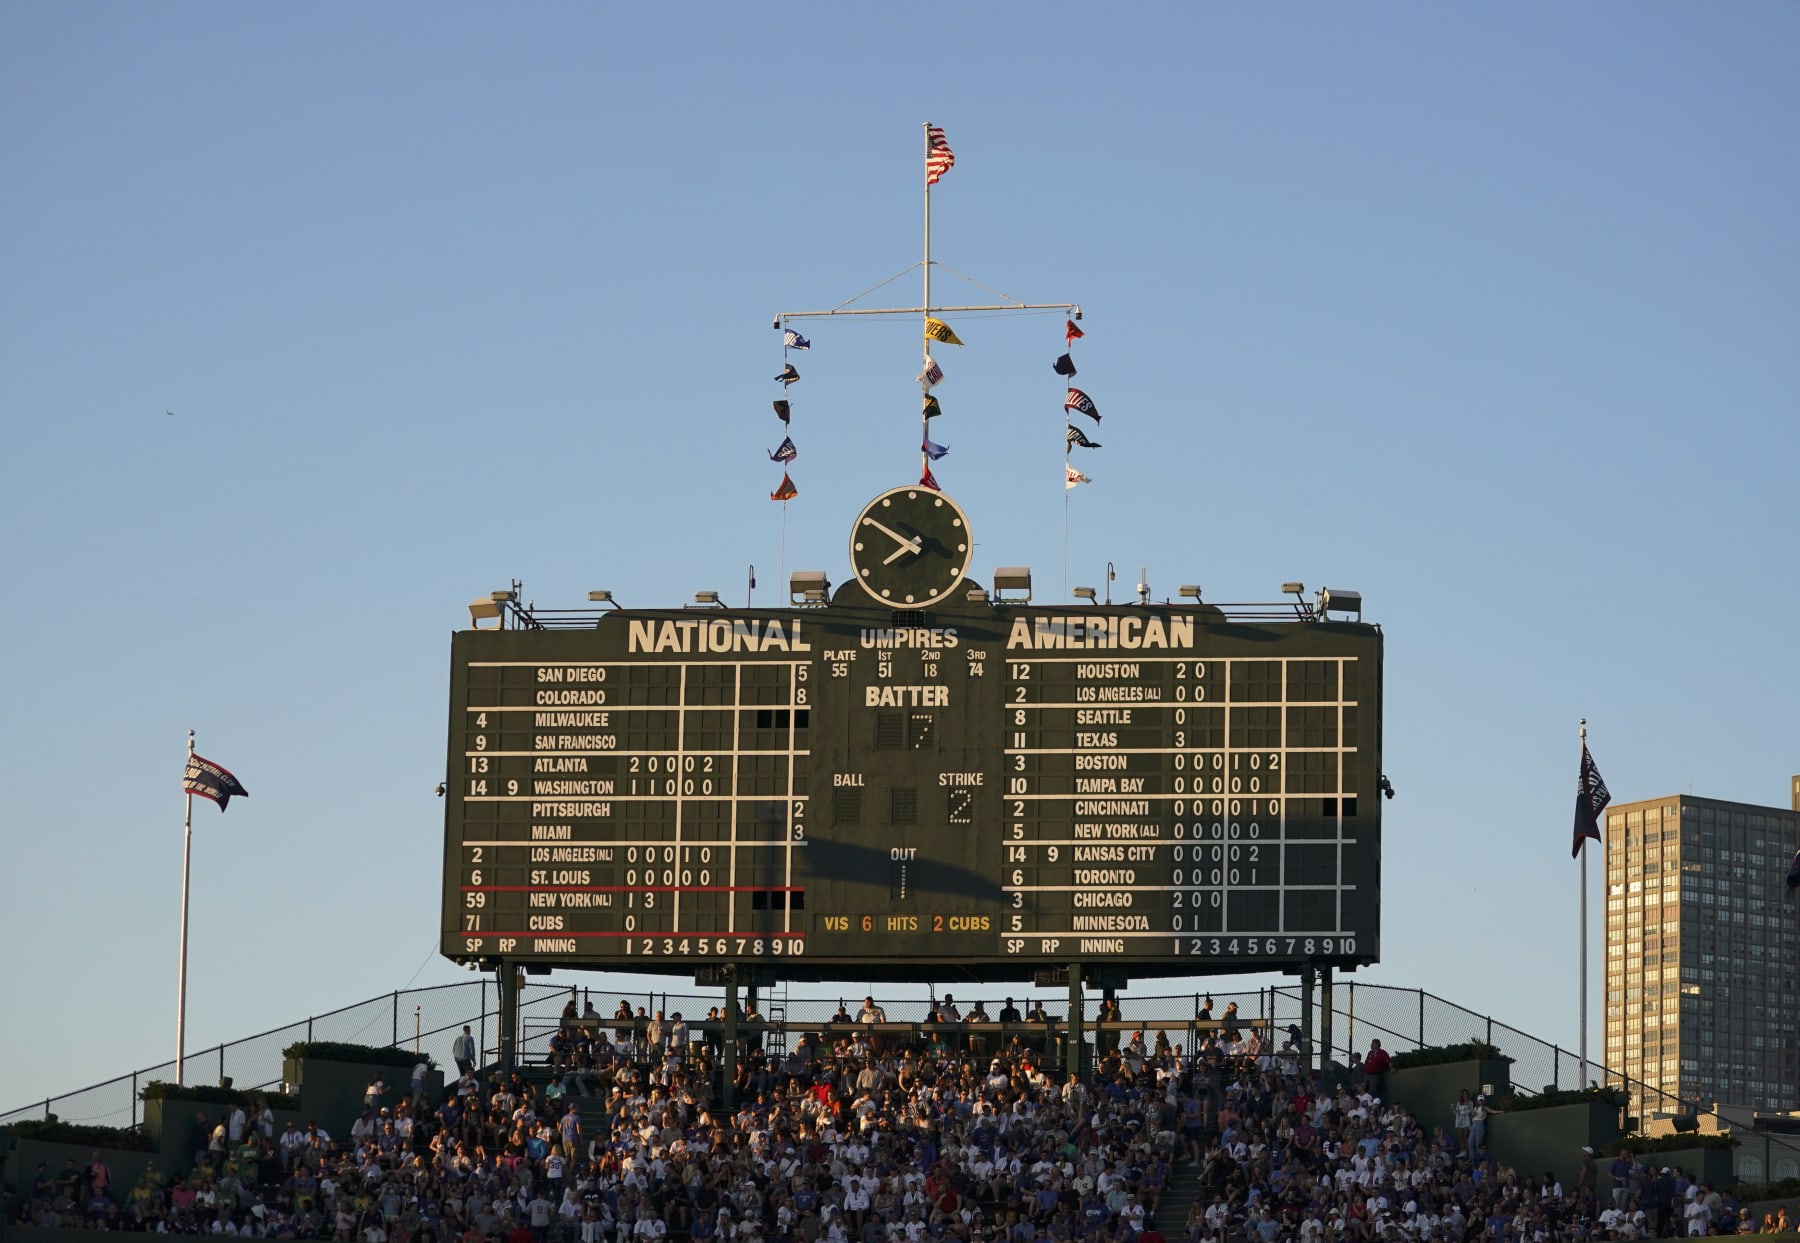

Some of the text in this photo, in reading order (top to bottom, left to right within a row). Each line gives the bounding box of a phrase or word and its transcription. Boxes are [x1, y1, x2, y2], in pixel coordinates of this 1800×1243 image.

[629, 619, 810, 652] NATIONAL
[861, 629, 958, 648] UMPIRES
[1007, 616, 1193, 649] AMERICAN
[824, 650, 986, 660] PLATE 1ST 2ND 3RD
[538, 666, 807, 682] SAN DIEGO 5
[832, 662, 983, 677] 55 51 18 74
[1013, 663, 1204, 679] 12 HOUSTON 2 0
[537, 688, 806, 704] COLORADO 8
[866, 686, 948, 706] BATTER
[1016, 687, 1026, 702] 2
[1077, 687, 1095, 701] LOS
[1176, 686, 1185, 701] 0
[477, 713, 608, 728] 4 MILWAUKEE
[1015, 709, 1185, 725] 8 SEATTLE 0
[912, 715, 932, 748] 7
[476, 736, 616, 750] 9 SAN FRANCISCO
[1015, 732, 1184, 748] 11 TEXAS 3
[472, 757, 712, 772] 13 ATLANTA 2 0 2
[1015, 754, 1278, 770] 3 BOSTON 0 2
[472, 780, 675, 795] 14 9 WASHINGTON 0
[834, 773, 983, 786] BALL STRIKE
[1012, 777, 1184, 793] 10 TAMPA BAY 0
[533, 802, 803, 817] PITTSBURGH 2
[950, 790, 970, 823] 2
[1014, 800, 1202, 816] 2 CINCINNATI 0 0
[532, 824, 803, 840] MIAMI 3
[1014, 824, 1023, 839] 5
[1075, 824, 1102, 838] NEW
[1175, 823, 1183, 838] 0
[1193, 823, 1202, 838] 0
[472, 848, 482, 862] 2
[532, 848, 549, 861] LOS
[628, 847, 636, 862] 0
[646, 848, 655, 862] 0
[891, 848, 916, 860] OUT
[1010, 846, 1258, 862] 14 9 KANSAS CITY 0 0 2
[472, 870, 654, 885] 6 ST. LOUIS 0 0
[901, 866, 905, 898] 1
[1013, 869, 1201, 885] 6 TORONTO 0 0
[467, 892, 485, 908] 59
[530, 893, 556, 906] NEW
[645, 892, 653, 908] 3
[1013, 892, 1220, 908] 3 CHICAGO 2 0 0
[466, 915, 634, 931] 71 CUBS 0
[825, 916, 989, 931] VIS 6 HITS 2 CUBS
[1012, 915, 1182, 931] 5 MINNESOTA 0
[466, 939, 482, 952] SP
[500, 939, 516, 952] RP
[535, 939, 575, 952] INNING
[643, 939, 652, 954] 2
[663, 939, 673, 954] 3
[679, 939, 690, 954] 4
[698, 939, 708, 954] 5
[716, 939, 726, 954] 6
[736, 940, 746, 954] 7
[753, 940, 763, 954] 8
[772, 939, 782, 954] 9
[788, 940, 803, 954] 10
[1008, 940, 1024, 953] SP
[1042, 940, 1059, 952] RP
[1081, 940, 1123, 952] INNING
[1191, 939, 1201, 954] 2
[1210, 939, 1220, 954] 3
[1229, 939, 1239, 954] 4
[1248, 939, 1258, 954] 5
[1266, 939, 1276, 954] 6
[1286, 939, 1295, 954] 7
[1304, 939, 1314, 954] 8
[1323, 939, 1333, 954] 9
[1340, 939, 1355, 954] 10
[550, 1161, 560, 1170] 30
